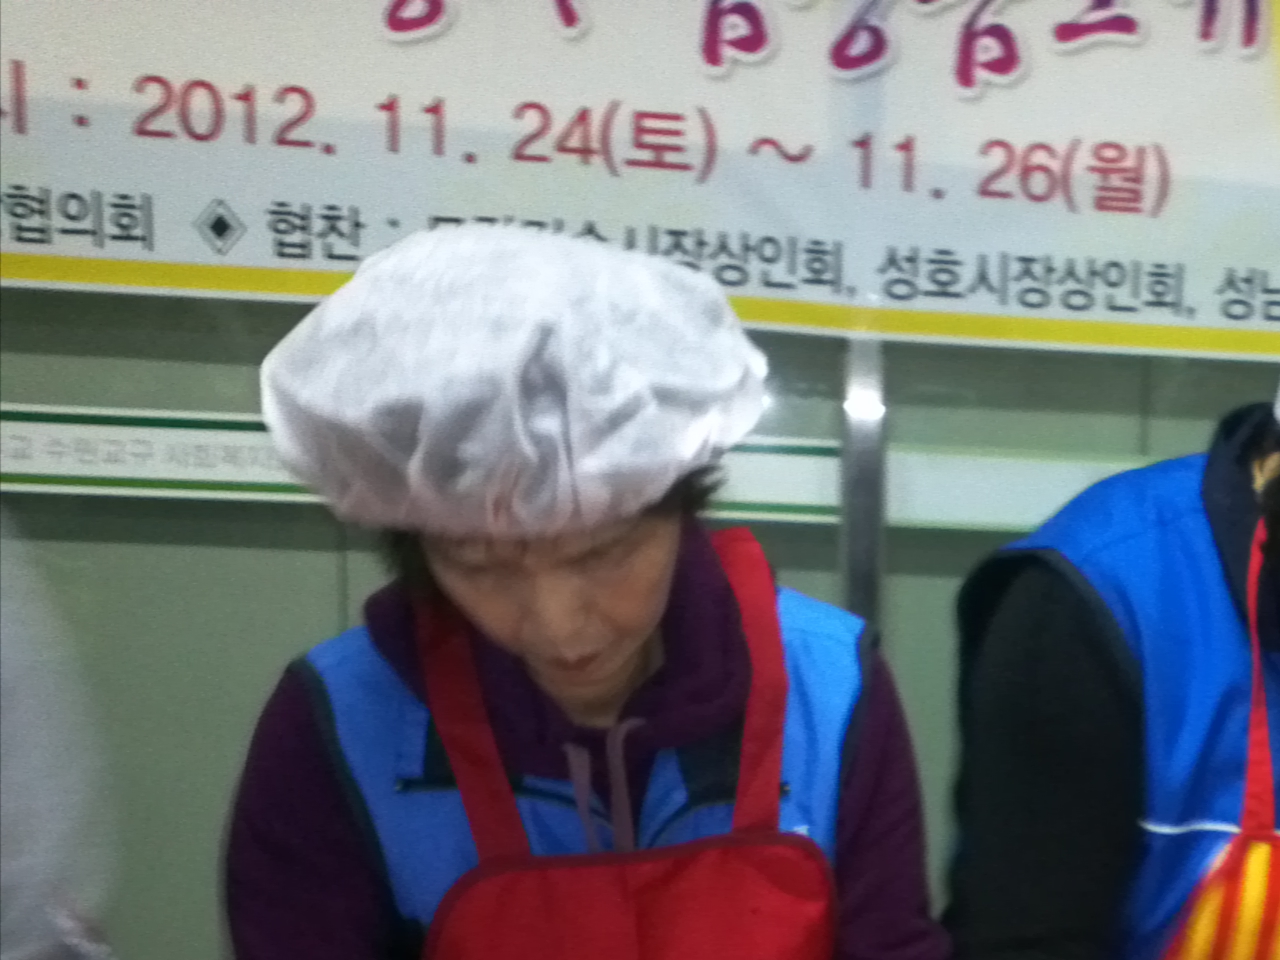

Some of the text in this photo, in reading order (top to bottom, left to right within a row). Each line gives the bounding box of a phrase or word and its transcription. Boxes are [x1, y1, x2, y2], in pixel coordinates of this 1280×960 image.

[131, 74, 336, 155] 2012.
[377, 94, 477, 165] 11.
[510, 100, 719, 182] 24(토)
[850, 132, 948, 201] 11.
[978, 138, 1171, 216] 26(월)
[3, 184, 154, 252] 협의회
[265, 200, 366, 262] 협찬
[877, 245, 1197, 319] 성호시장상인회,
